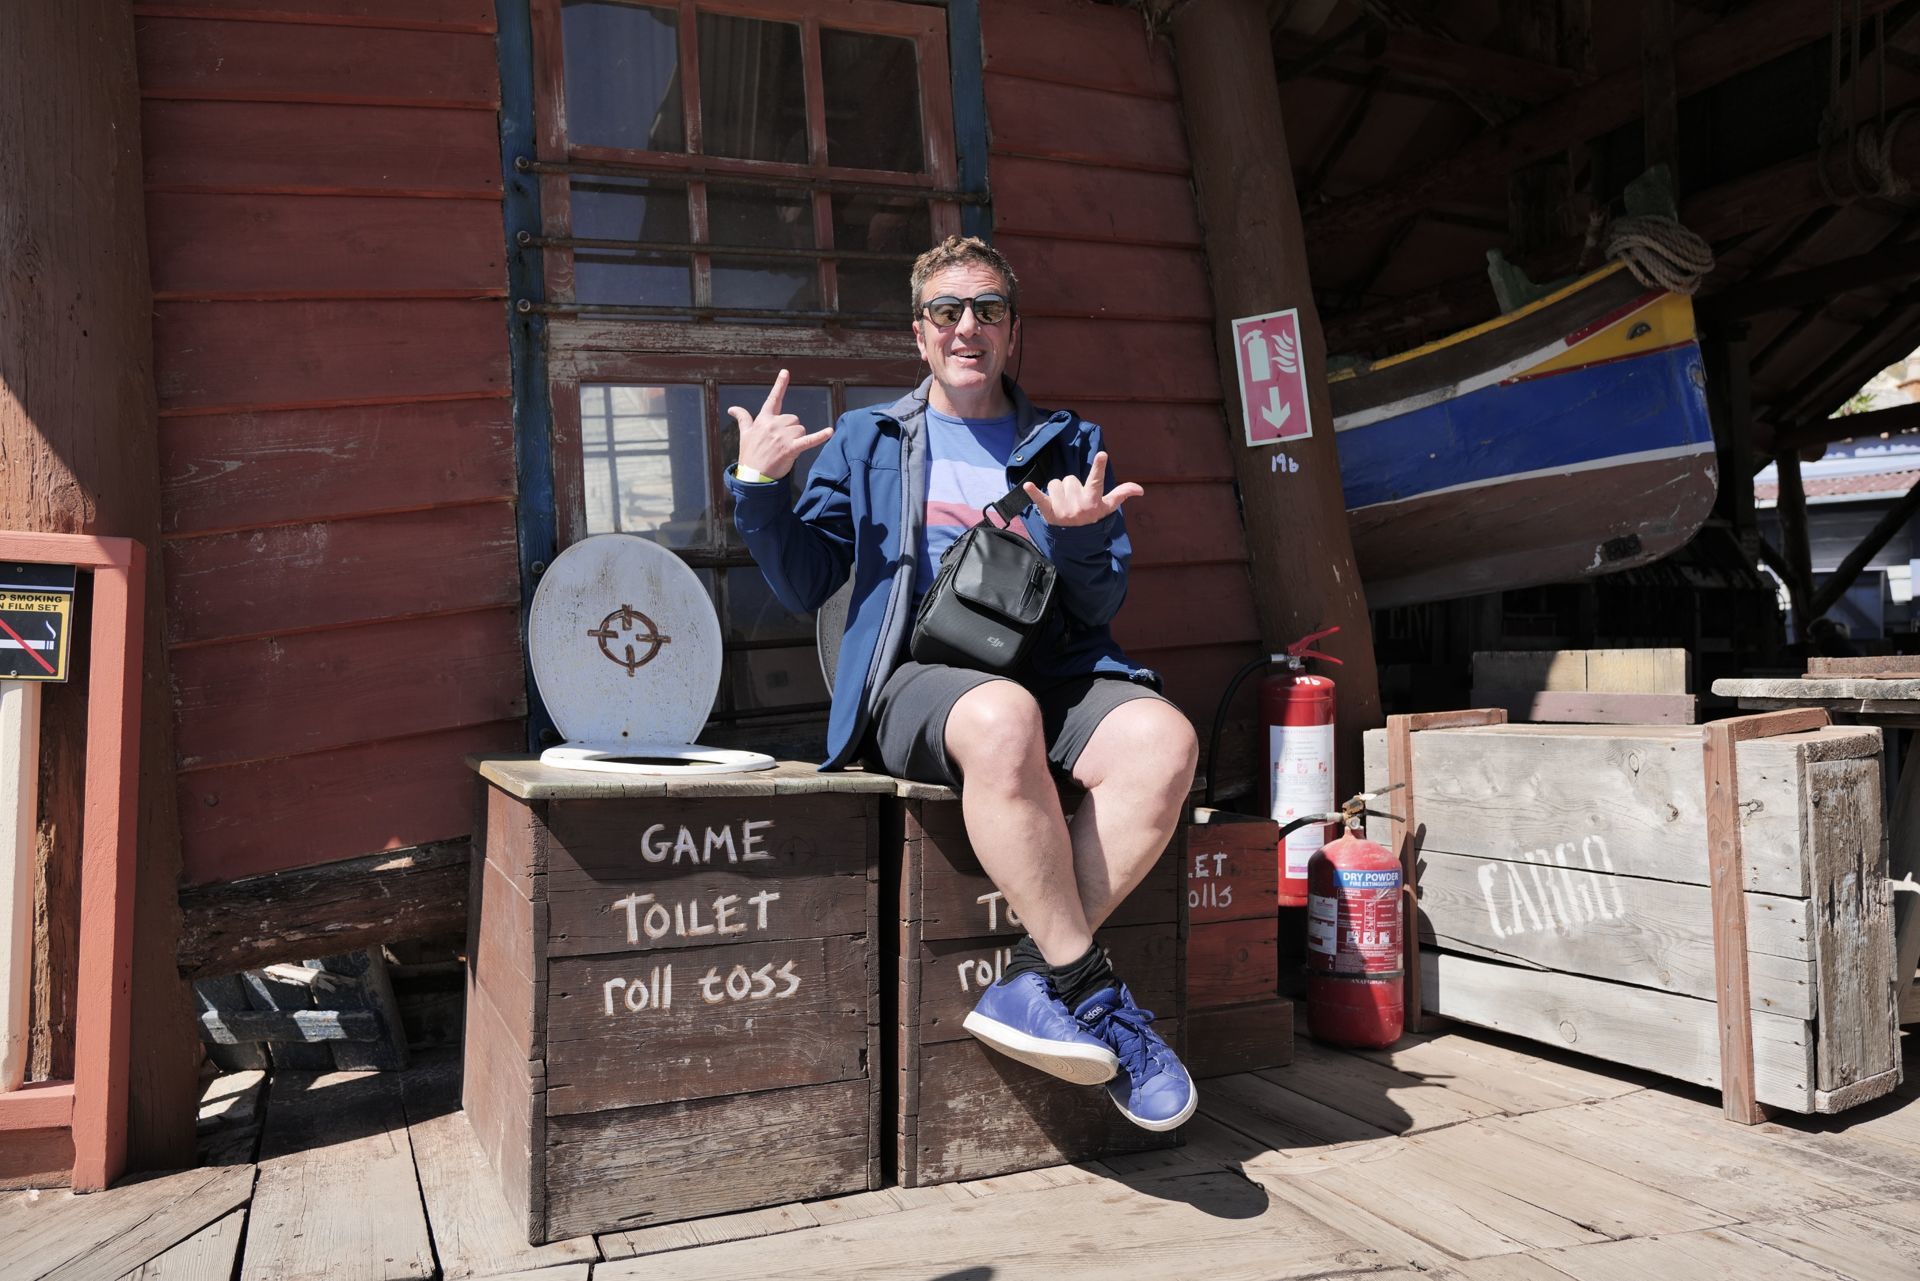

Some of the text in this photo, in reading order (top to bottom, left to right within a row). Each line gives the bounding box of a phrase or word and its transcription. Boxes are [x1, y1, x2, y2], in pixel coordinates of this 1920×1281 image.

[0, 593, 62, 603] O SMOKING
[640, 818, 776, 865] GAME
[1187, 851, 1228, 878] ET
[1342, 872, 1399, 882] DRY POWDER
[1188, 882, 1232, 908] olls
[1477, 834, 1626, 939] CARGO
[612, 889, 780, 945] TOILET
[603, 959, 802, 1016] roll toss
